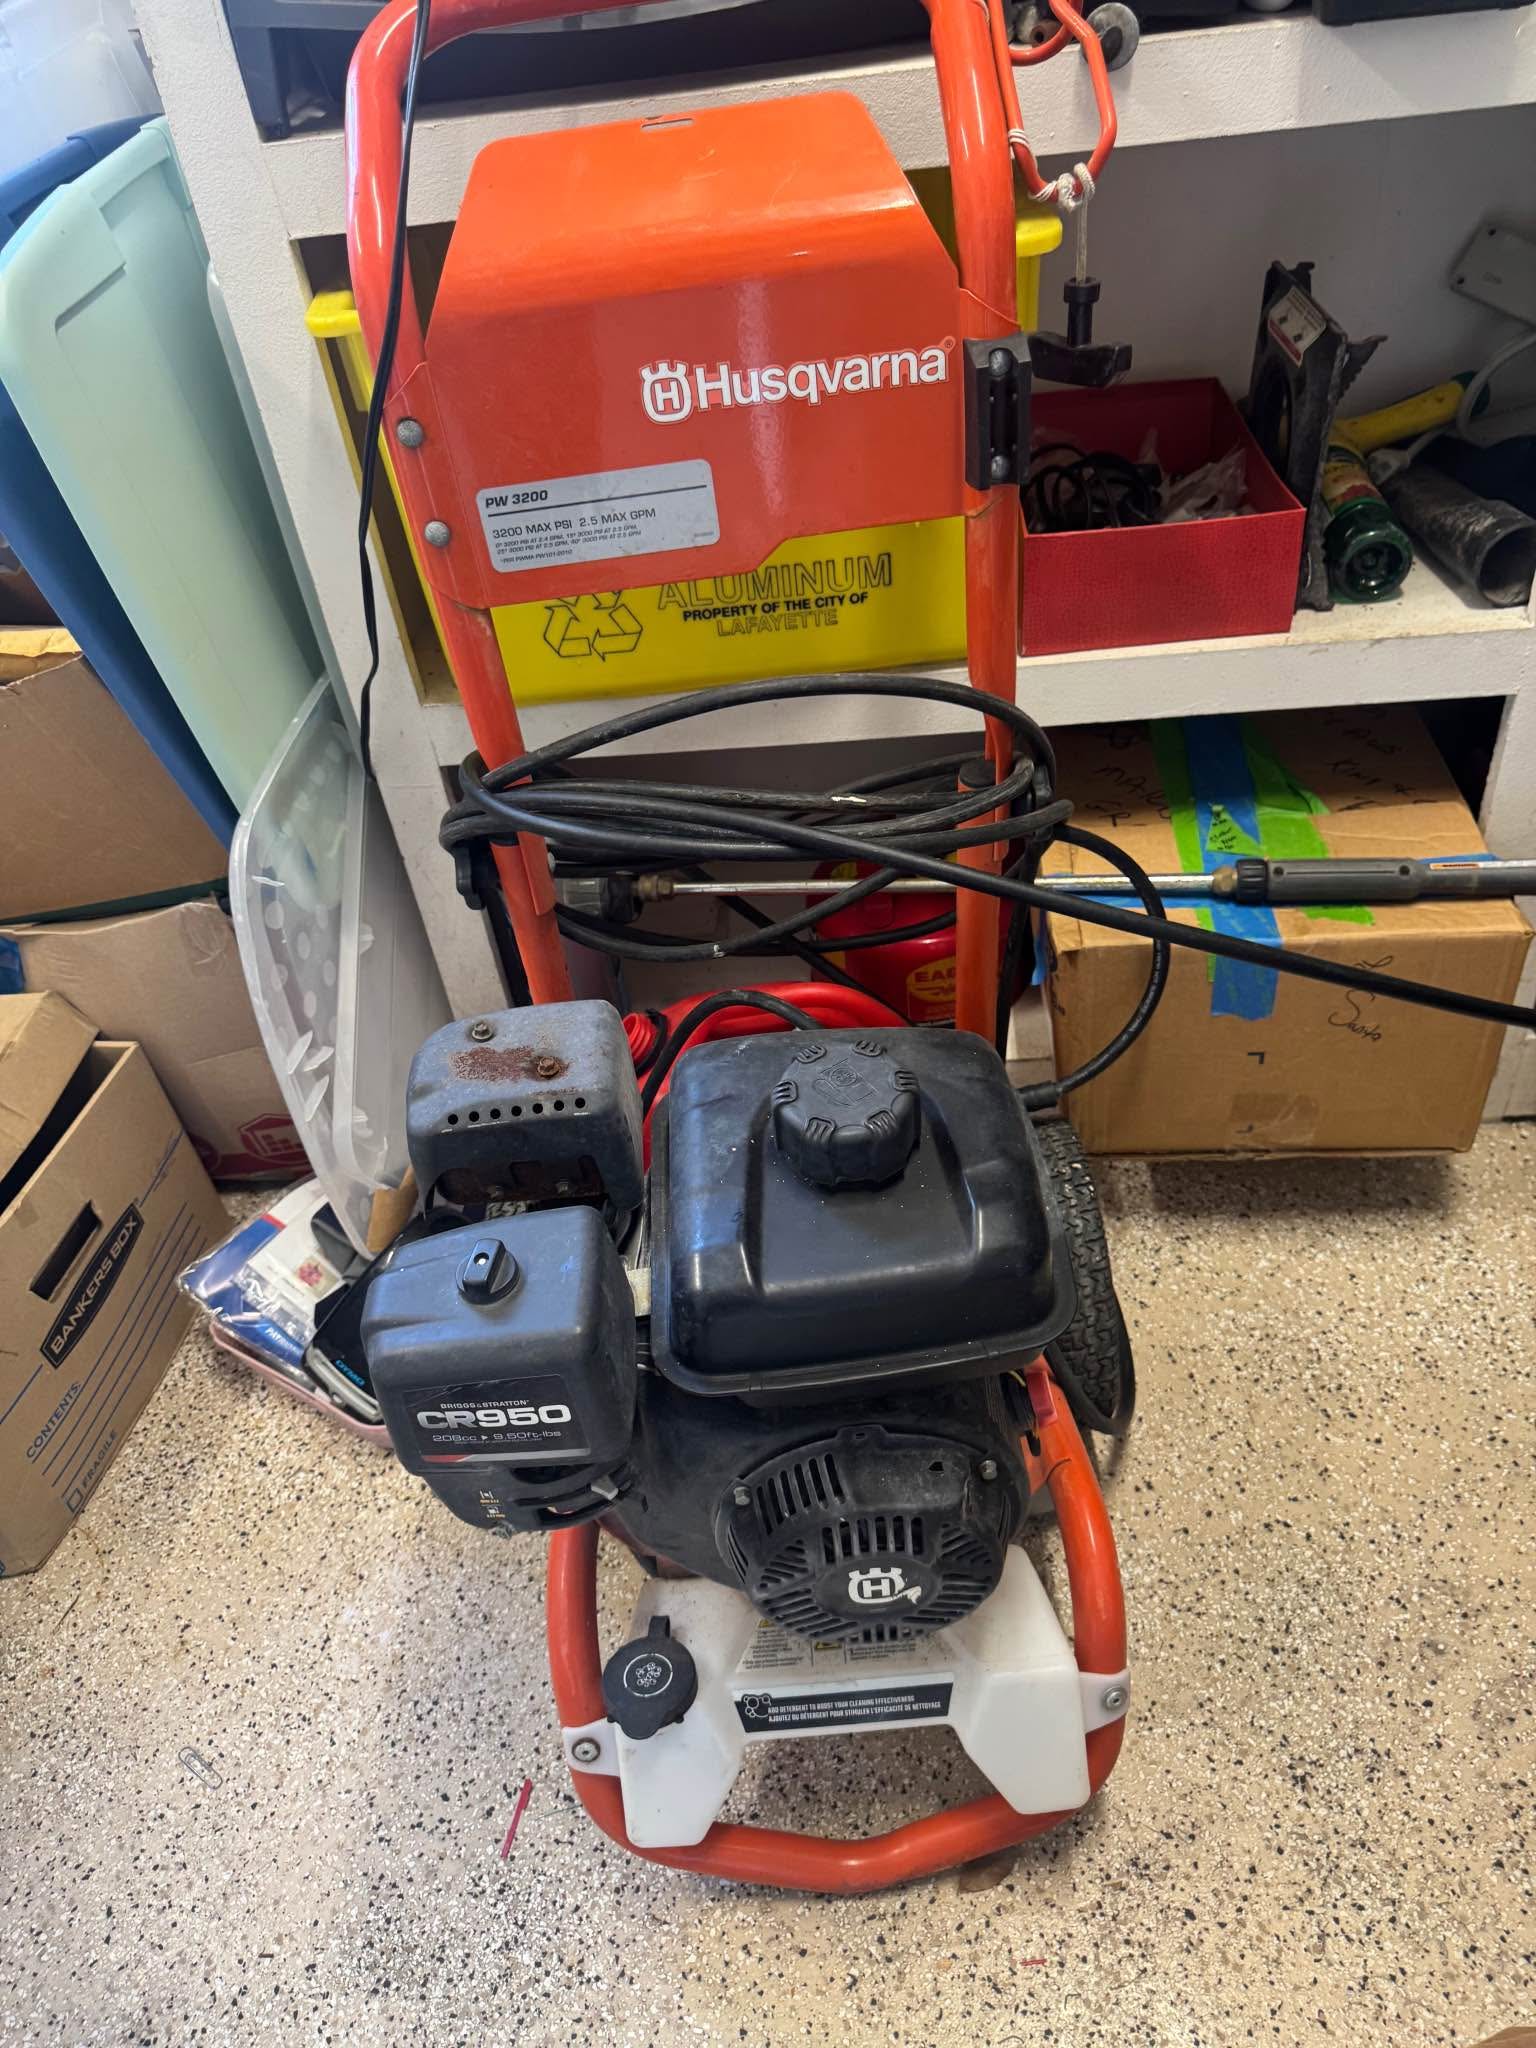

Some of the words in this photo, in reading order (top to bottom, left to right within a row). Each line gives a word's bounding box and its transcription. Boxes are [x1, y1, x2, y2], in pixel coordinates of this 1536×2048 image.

[694, 347, 948, 410] Husqvarna
[485, 495, 508, 509] PW
[512, 490, 548, 504] 3200
[492, 526, 523, 539] 3200
[525, 522, 552, 535] MAX
[554, 519, 573, 531] PSI
[579, 516, 598, 527] 2.5
[601, 511, 627, 524] MAX
[630, 508, 656, 520] GPM
[657, 552, 893, 610] ALUMINUM
[682, 604, 757, 622] PROPERTY
[761, 602, 781, 614] OF
[784, 599, 811, 612] THE
[814, 594, 845, 608] CITY
[848, 591, 869, 605] OF
[716, 608, 839, 637] LAFAYETTE
[51, 1256, 113, 1354] BANKERS
[110, 1215, 138, 1259] BOX
[334, 1358, 366, 1387] DYMO
[416, 1404, 572, 1429] CR950
[432, 1434, 477, 1442] 208cc
[493, 1430, 562, 1441] 9.50ft-lbs
[81, 1429, 118, 1489] FRAGILE
[779, 1704, 809, 1713] DETERGENT
[834, 1700, 849, 1708] YOUR
[849, 1698, 875, 1707] CLEANING
